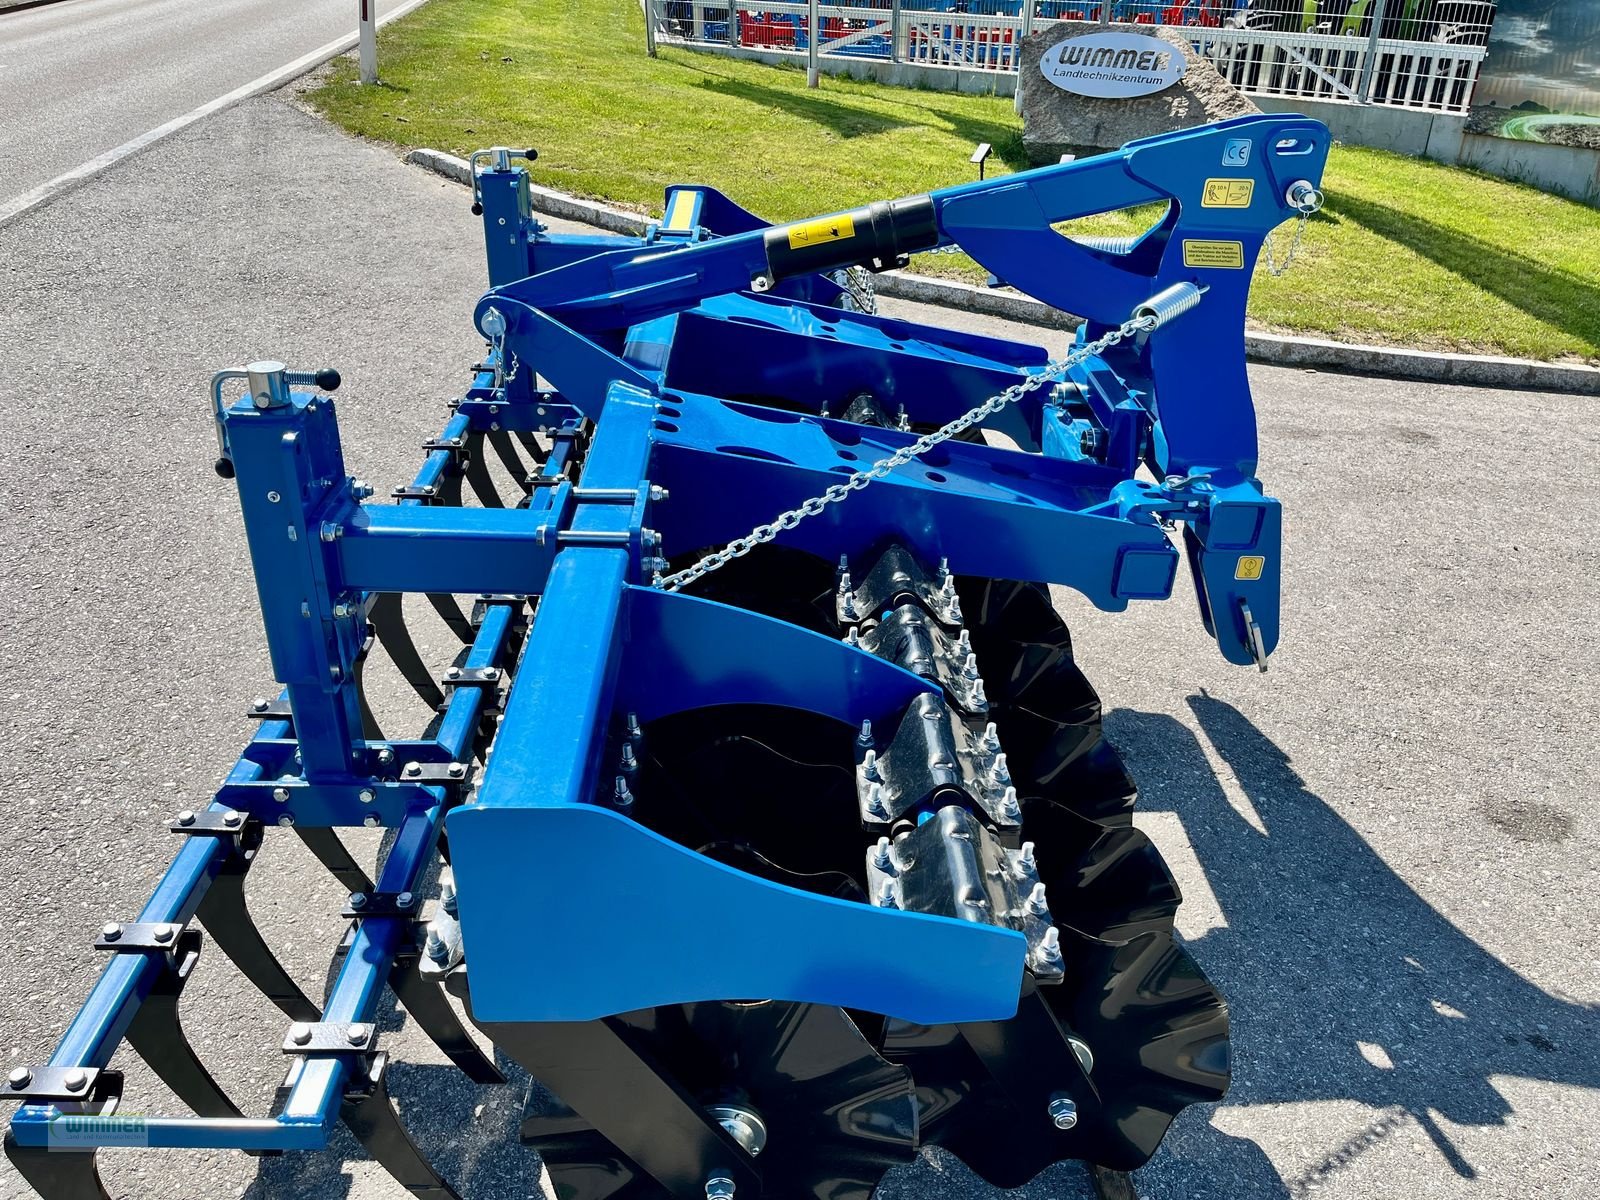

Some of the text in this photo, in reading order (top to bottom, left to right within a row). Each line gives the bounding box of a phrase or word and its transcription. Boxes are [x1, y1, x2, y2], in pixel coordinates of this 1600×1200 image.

[1058, 46, 1170, 71] WIMMER
[1053, 67, 1163, 85] Landtechnikzentrum
[1228, 145, 1247, 160] CE
